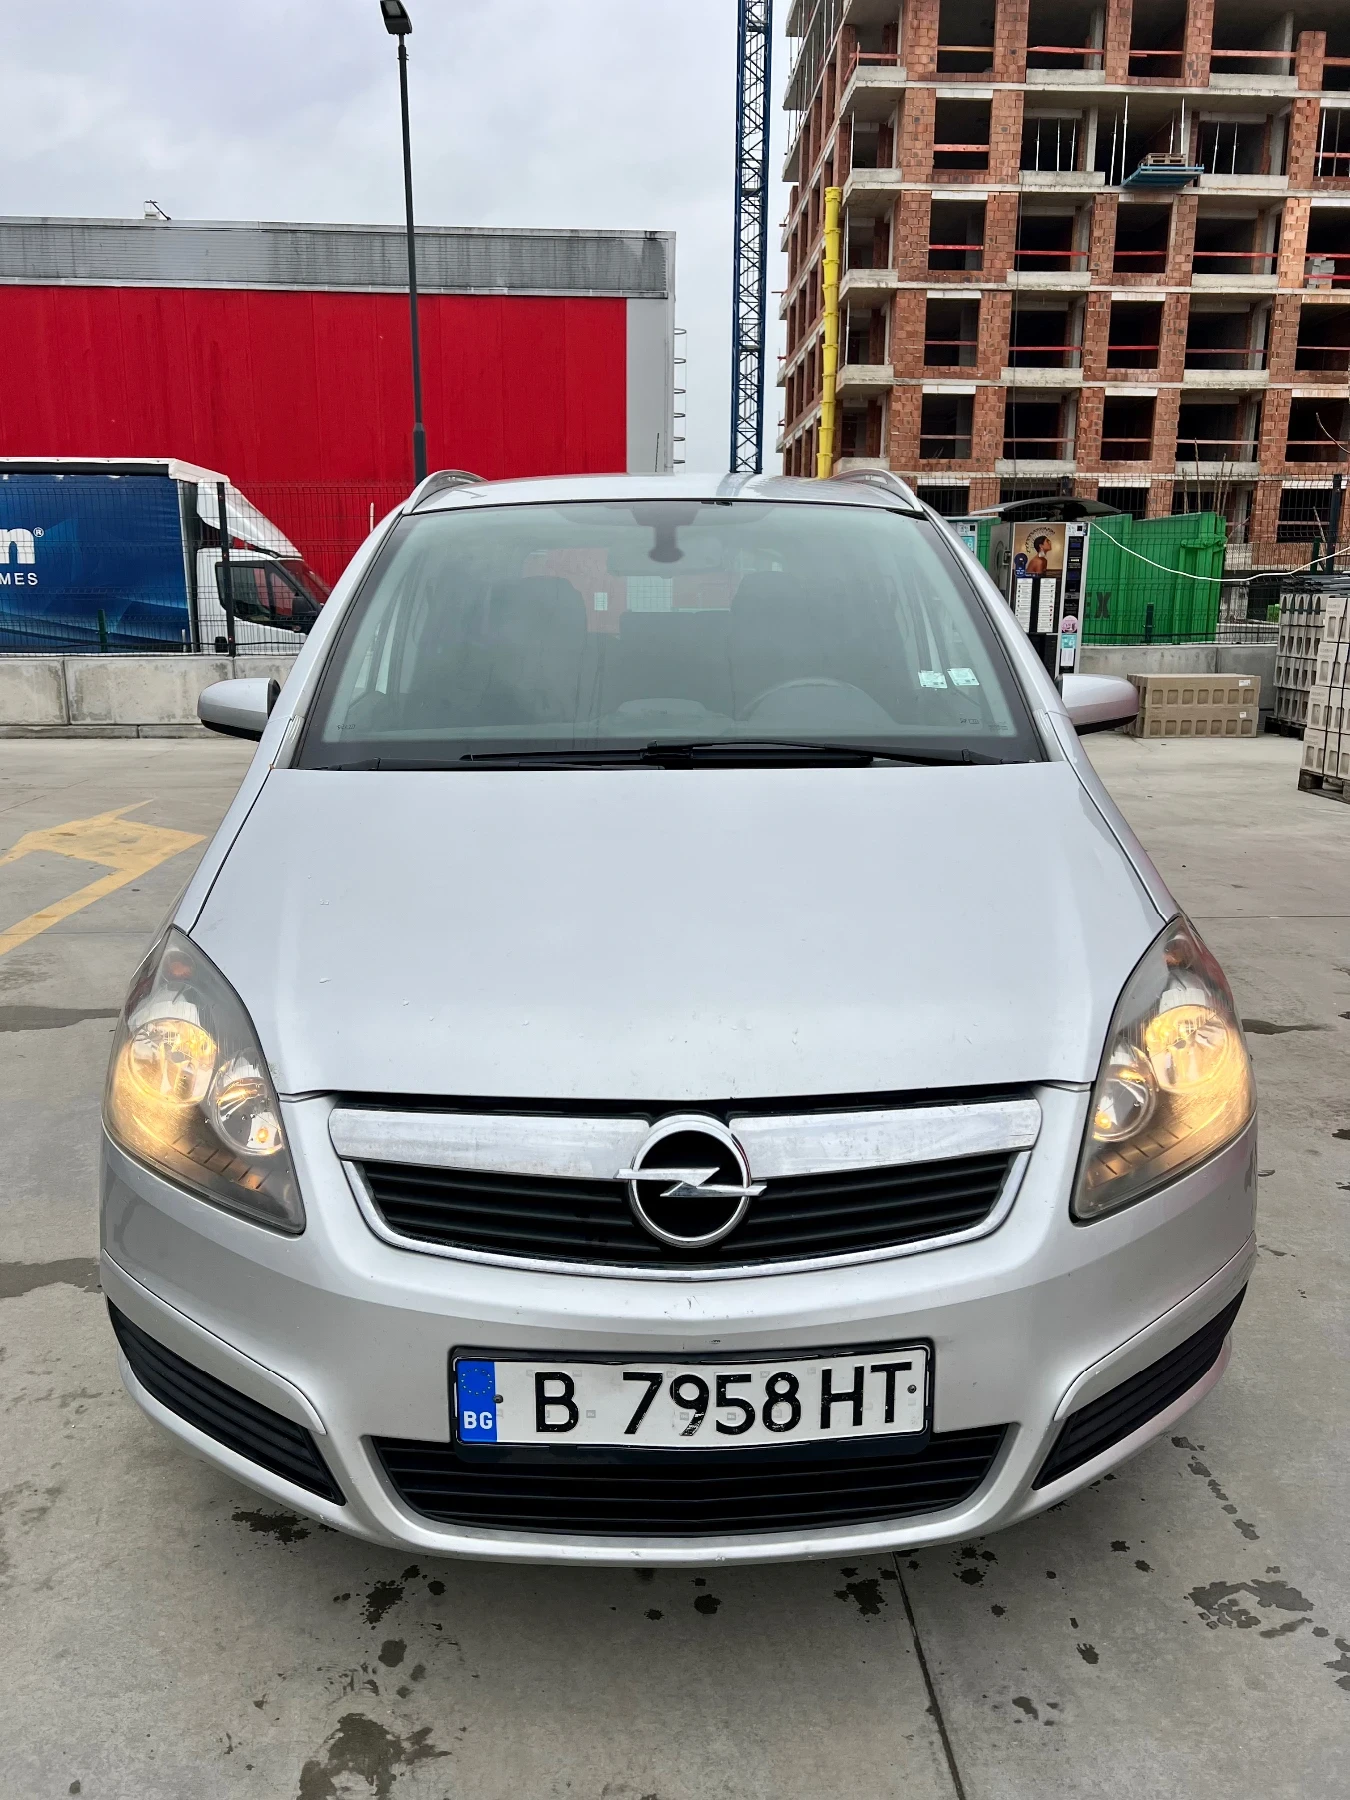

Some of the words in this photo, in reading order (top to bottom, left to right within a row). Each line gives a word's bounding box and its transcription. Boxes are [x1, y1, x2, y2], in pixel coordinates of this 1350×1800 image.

[0, 572, 38, 585] MES
[534, 1371, 580, 1433] B
[622, 1371, 802, 1437] 7958
[819, 1361, 913, 1430] HT
[463, 1410, 493, 1430] BG
